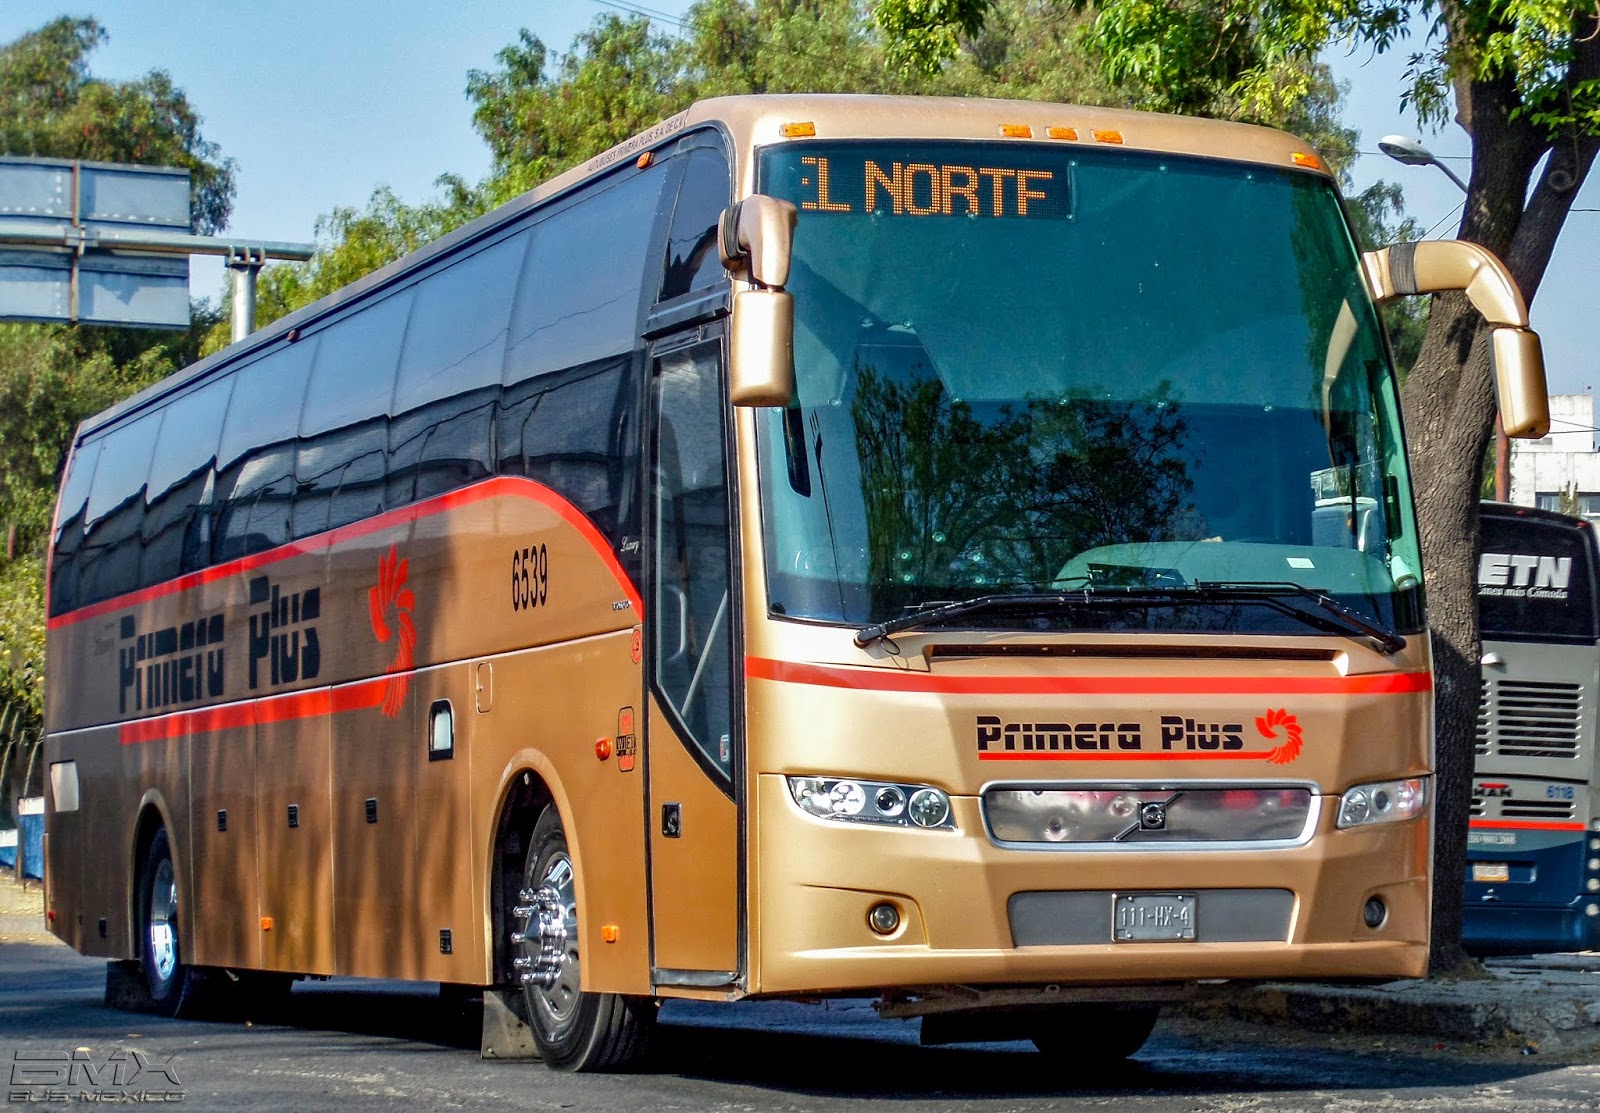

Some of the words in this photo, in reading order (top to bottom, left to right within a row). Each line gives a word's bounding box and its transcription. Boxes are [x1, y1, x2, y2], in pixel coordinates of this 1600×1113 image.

[512, 542, 548, 612] 6539
[1478, 553, 1572, 588] ETN
[119, 613, 224, 715] Primera
[249, 575, 320, 690] Plus
[976, 715, 1142, 751] Primera
[1160, 715, 1244, 751] Plus
[1121, 906, 1189, 927] 111-HX-4
